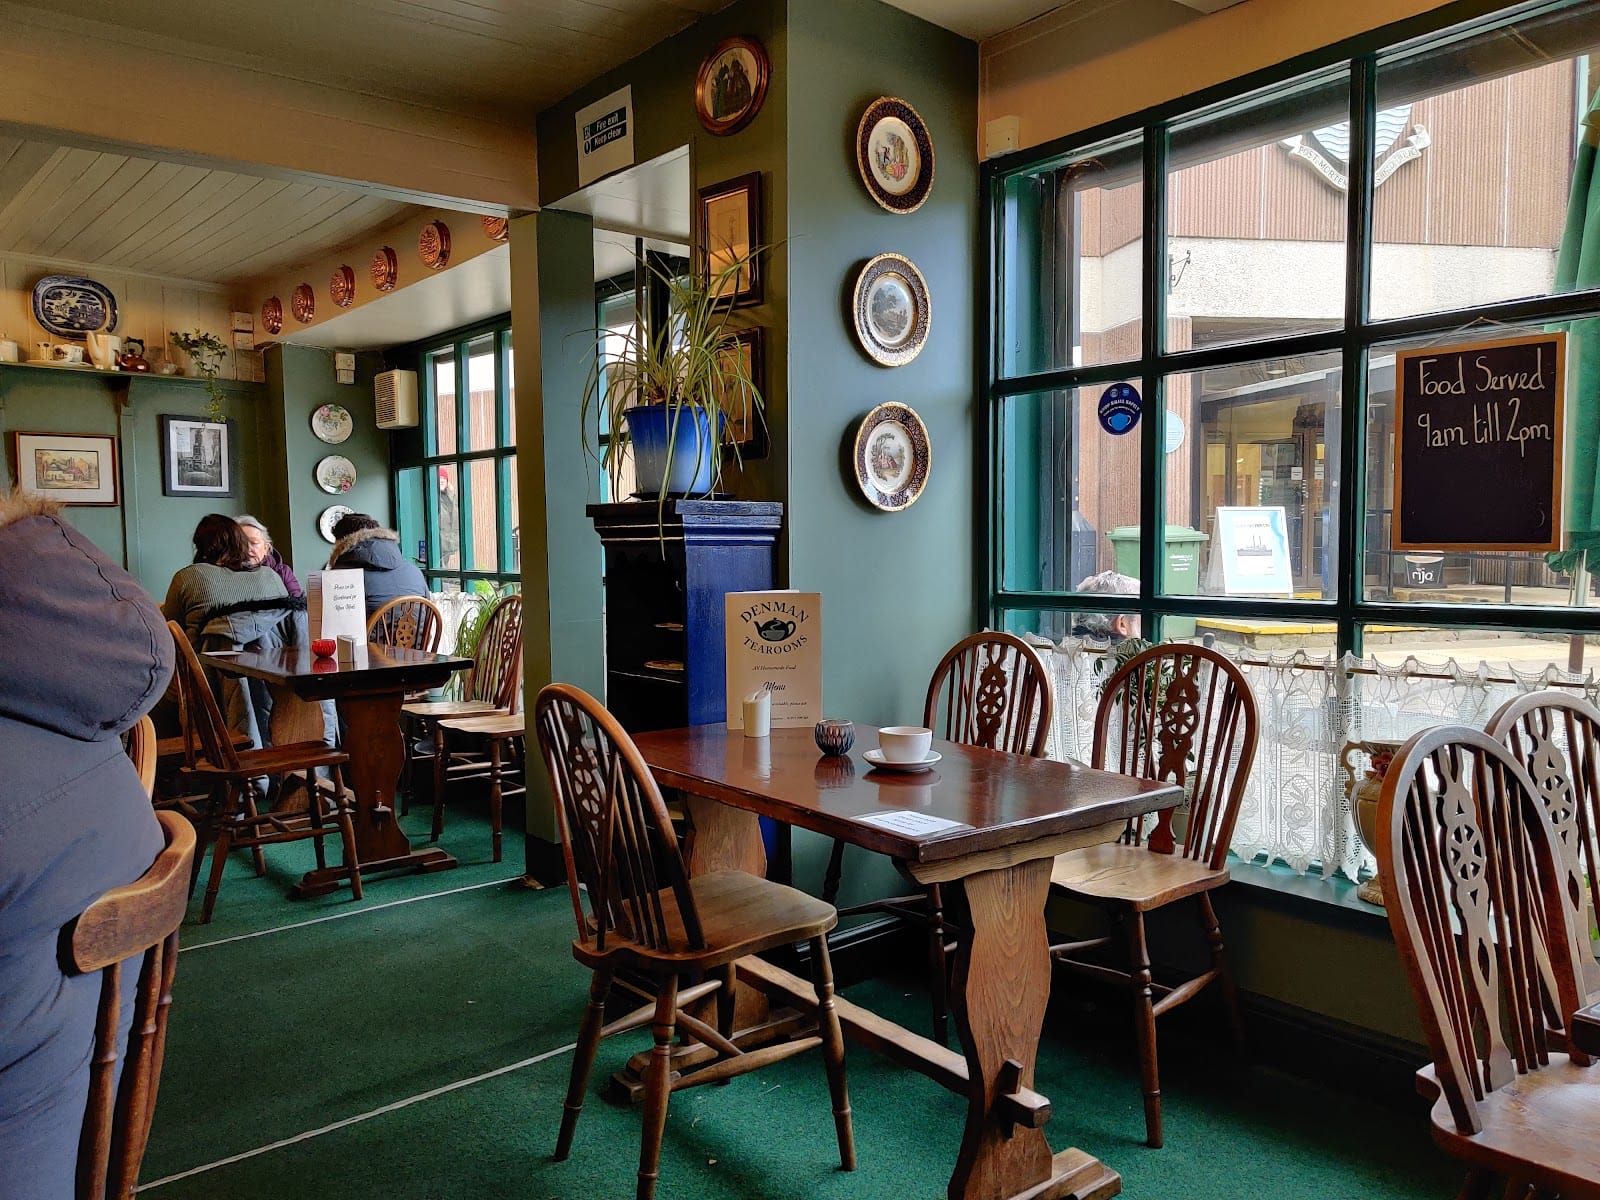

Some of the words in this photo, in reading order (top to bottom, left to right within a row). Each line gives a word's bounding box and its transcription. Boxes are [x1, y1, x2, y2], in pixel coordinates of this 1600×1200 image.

[596, 120, 607, 132] Fire
[607, 112, 619, 126] exit
[594, 133, 607, 147] Keep
[607, 127, 621, 140] clear
[1299, 146, 1318, 161] POST
[1419, 355, 1466, 396] Food
[1475, 347, 1545, 392] Served
[1417, 413, 1468, 448] 9am
[1473, 402, 1500, 444] till
[1506, 398, 1551, 458] 2pm
[740, 601, 809, 624] DENMAN
[743, 634, 808, 655] TEAROOMS
[763, 681, 786, 693] Menu
